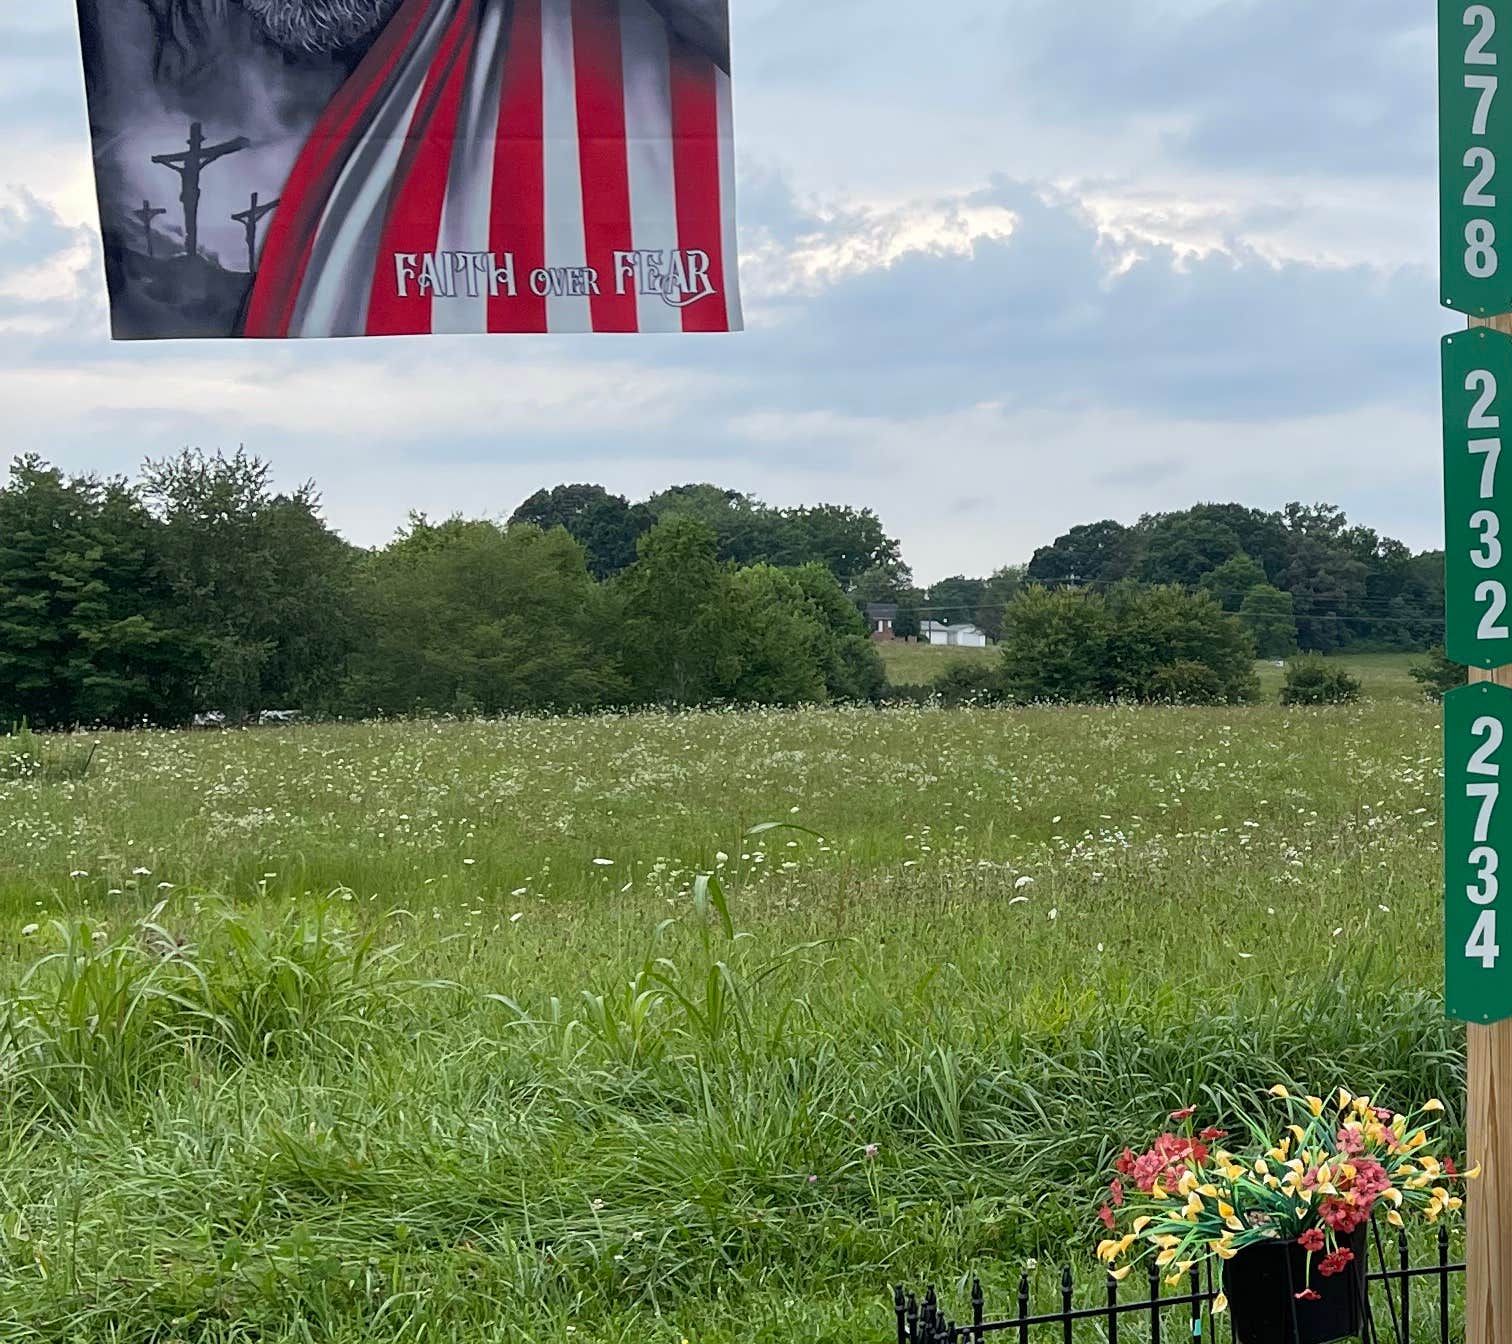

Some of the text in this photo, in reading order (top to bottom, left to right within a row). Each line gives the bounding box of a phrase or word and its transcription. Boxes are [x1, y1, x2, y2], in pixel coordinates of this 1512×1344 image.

[1462, 5, 1498, 278] 2728
[394, 249, 717, 307] FAITH OVER FEAR
[1464, 369, 1509, 640] 2732
[1464, 716, 1504, 969] 2734
